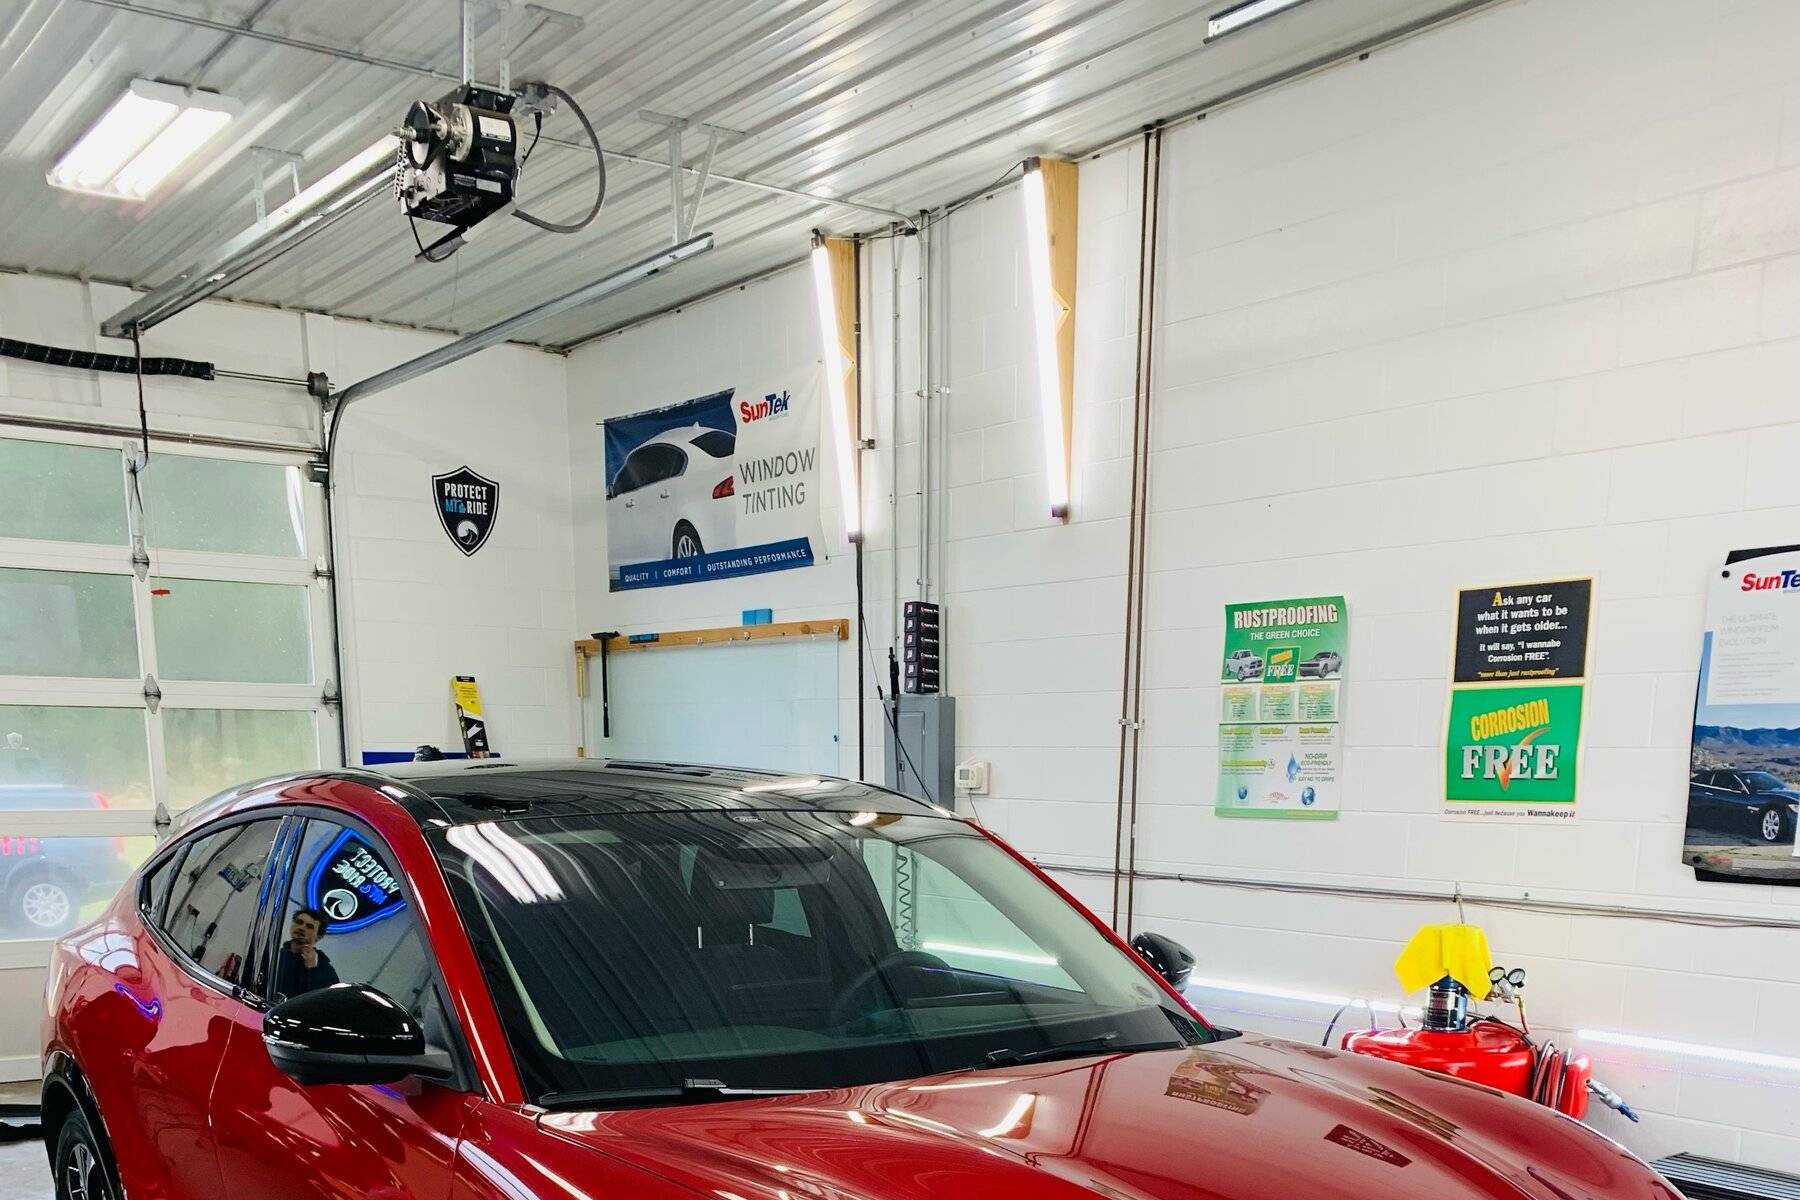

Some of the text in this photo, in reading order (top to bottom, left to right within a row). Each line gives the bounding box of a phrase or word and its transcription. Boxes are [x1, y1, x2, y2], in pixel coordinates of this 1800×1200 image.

[740, 390, 791, 423] SunTek
[739, 447, 815, 485] WINDOW
[444, 482, 488, 501] PROTECT
[743, 482, 806, 515] TINTING
[466, 500, 488, 515] RIDE
[624, 549, 807, 583] QUALITY COMFORT OUTSTANDING PERFORMANCE
[1491, 591, 1553, 607] Ask any car
[1233, 604, 1338, 629] RUSTPROOFING
[1477, 605, 1569, 622] what it wants to be
[1250, 628, 1321, 641] THE GREEN CHOICE
[1475, 620, 1568, 635] when it gets older...
[1487, 642, 1500, 651] will
[1526, 639, 1561, 649] wannabe
[1488, 654, 1523, 663] Corrosion
[1266, 664, 1295, 677] FREE
[1470, 698, 1550, 742] CORROSION
[1460, 743, 1561, 780] FREE
